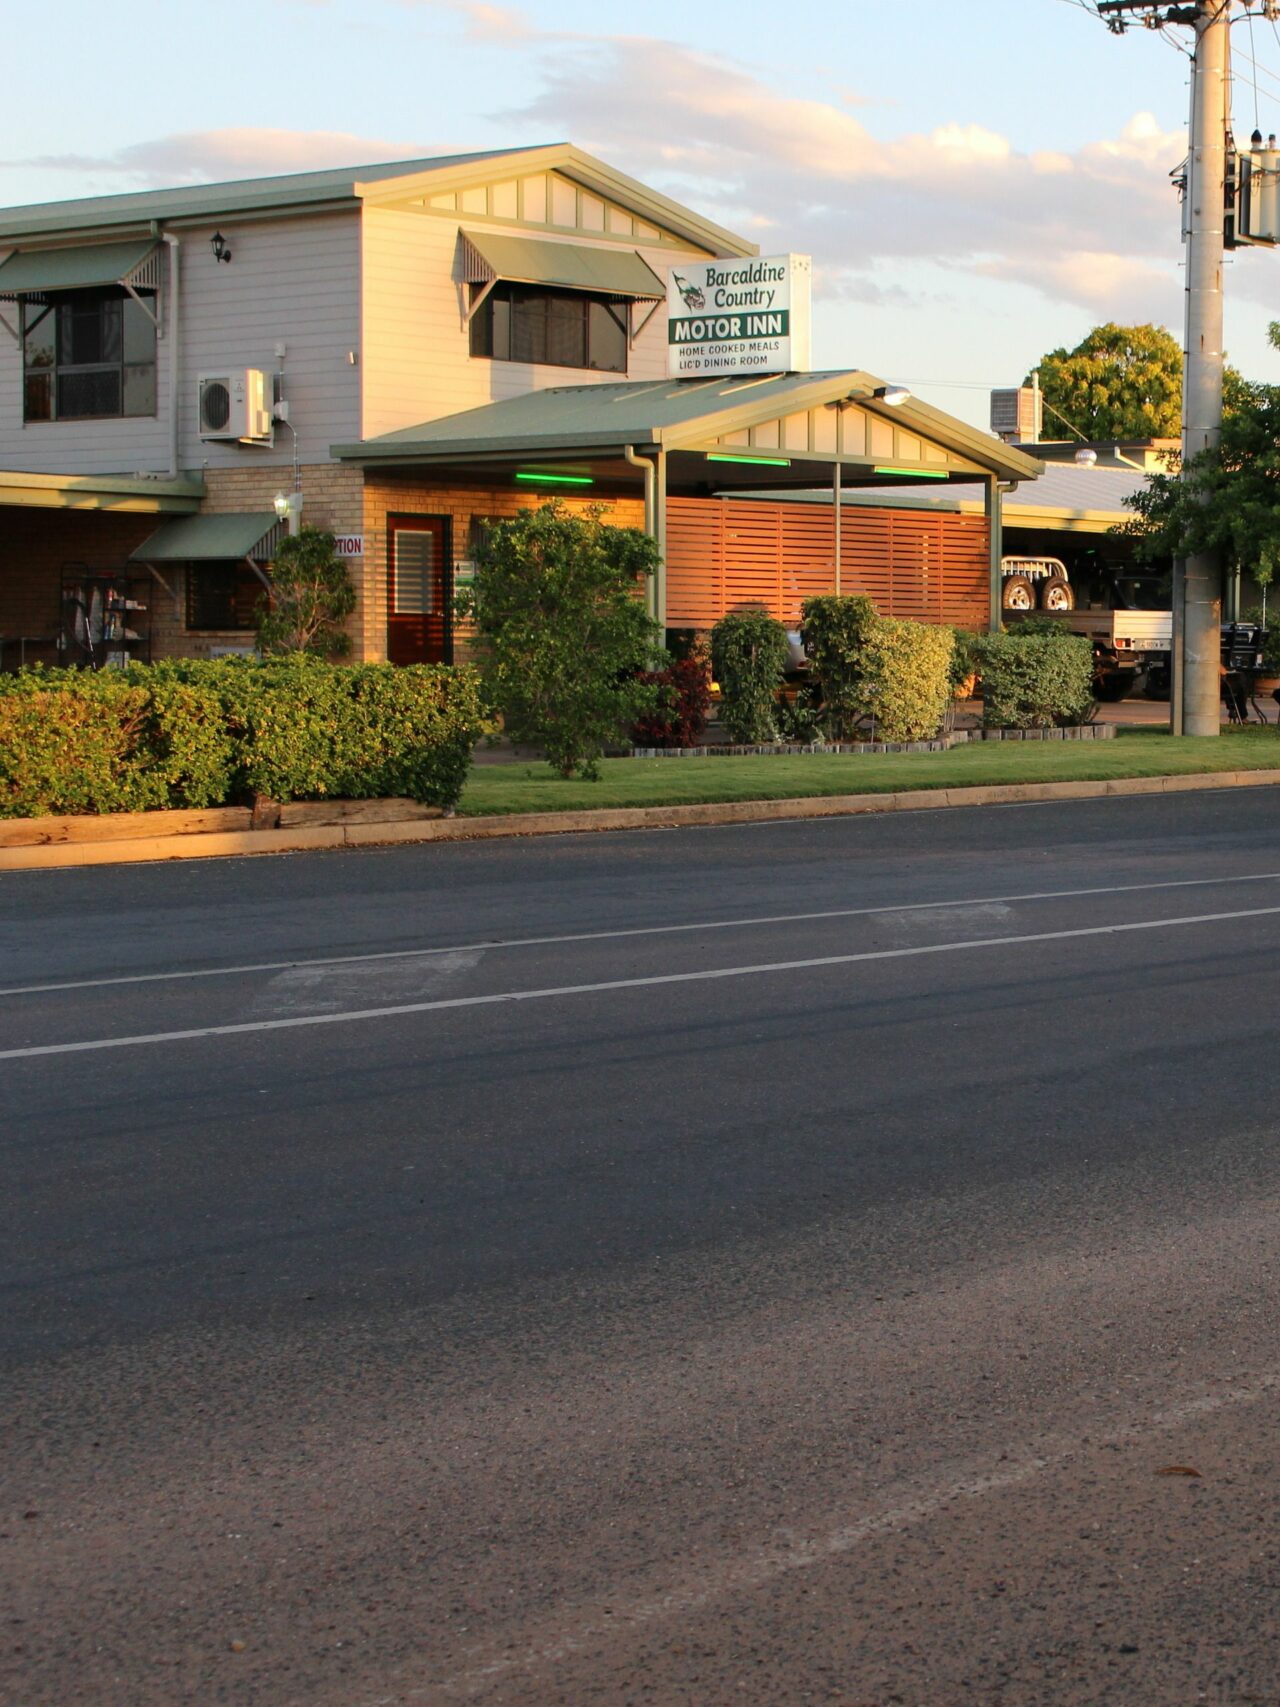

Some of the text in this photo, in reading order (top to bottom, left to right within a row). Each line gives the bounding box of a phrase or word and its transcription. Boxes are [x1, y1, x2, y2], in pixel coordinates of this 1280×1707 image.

[706, 262, 785, 287] Barcaldine
[715, 288, 775, 309] Country
[675, 314, 782, 341] MOTOR INN
[679, 341, 779, 357] HOME COOKED MEALS
[679, 356, 768, 369] LIC'D DINING ROOM
